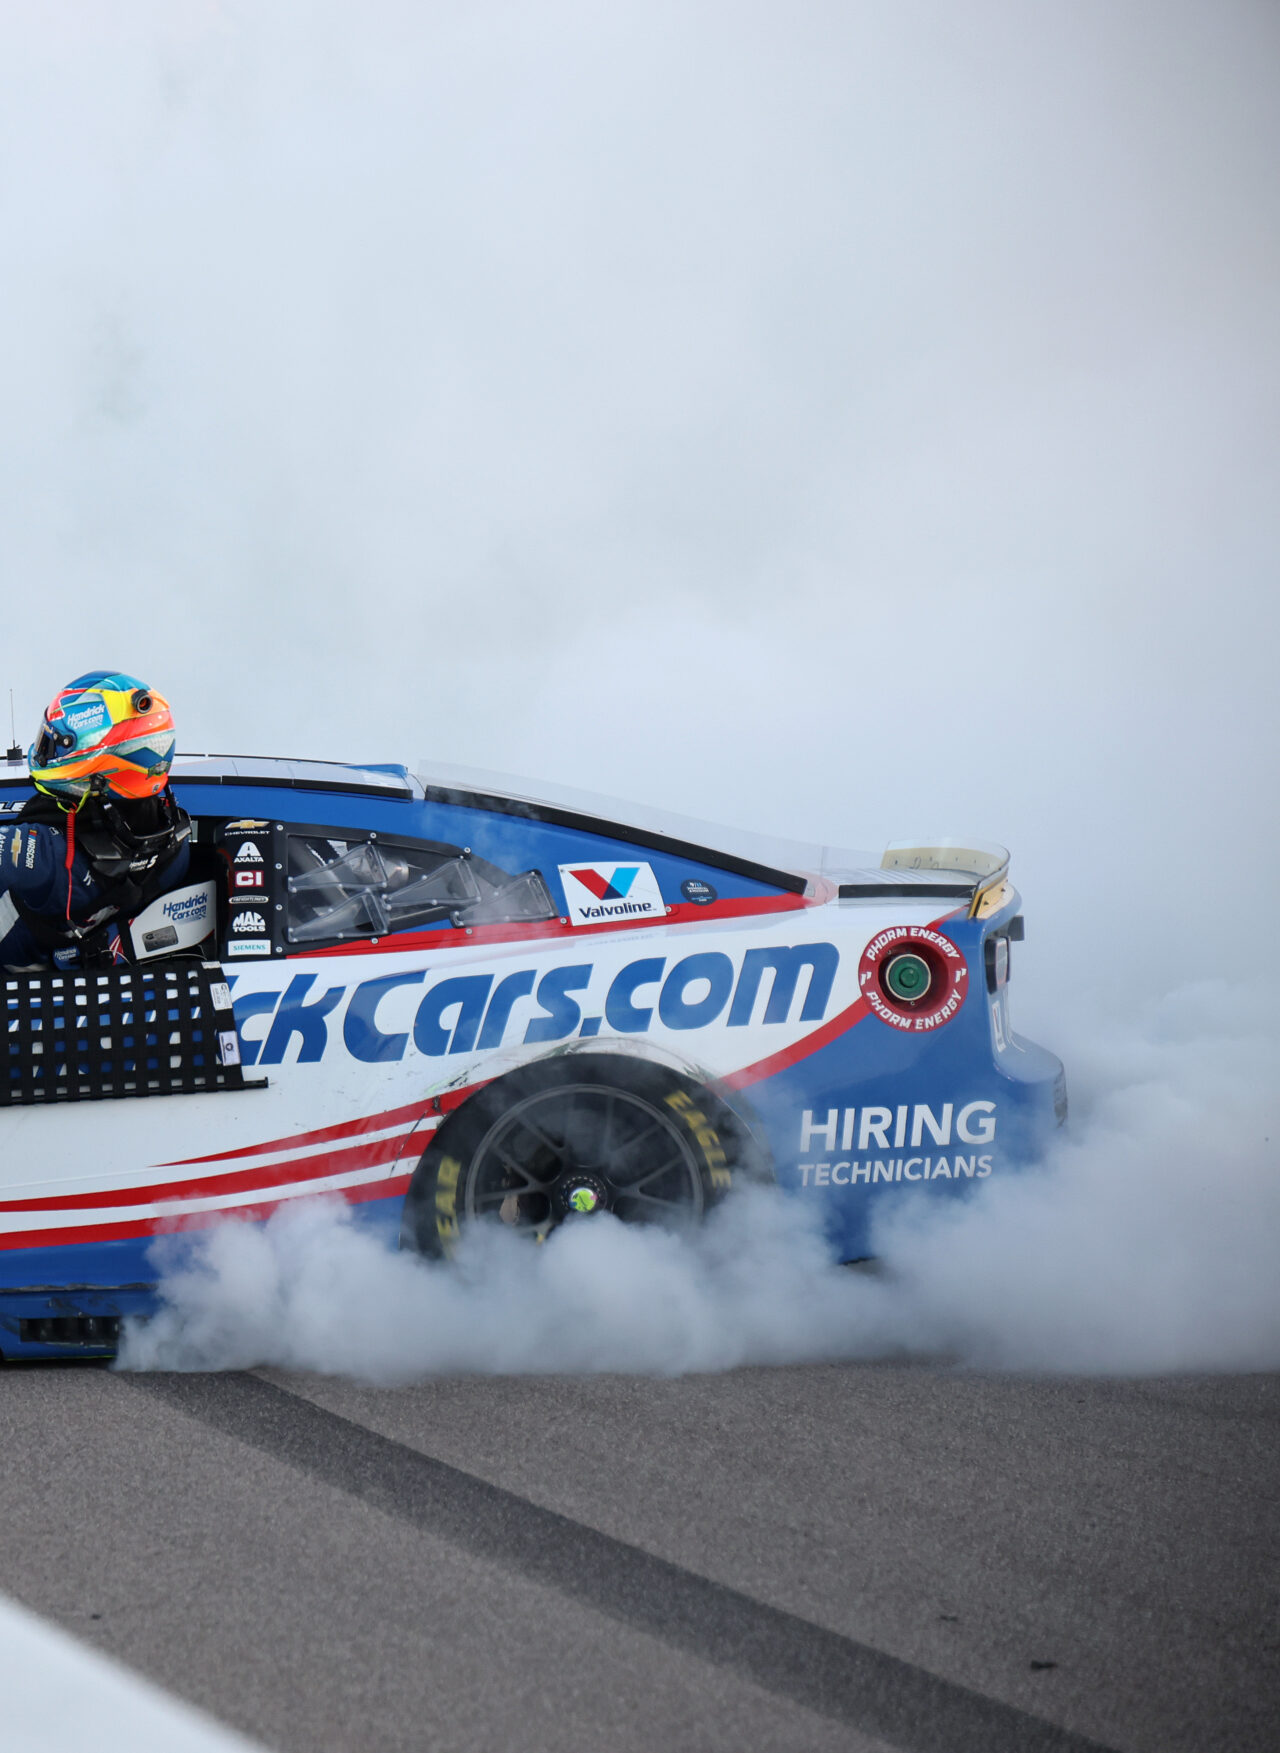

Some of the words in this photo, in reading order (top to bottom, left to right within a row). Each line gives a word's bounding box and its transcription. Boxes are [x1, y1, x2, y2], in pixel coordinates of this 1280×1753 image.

[67, 704, 105, 726] Hendrick
[25, 838, 37, 870] NASCAR
[236, 872, 262, 885] CI
[162, 892, 208, 917] Hendrick
[172, 904, 207, 921] Cars.com
[579, 902, 653, 918] Valvoline
[232, 911, 266, 927] MAC
[910, 927, 960, 958] ENERGY
[915, 988, 962, 1029] ENERGY
[664, 1089, 732, 1188] EAGLE
[799, 1101, 998, 1153] HIRING
[798, 1156, 993, 1187] TECHNICIANS
